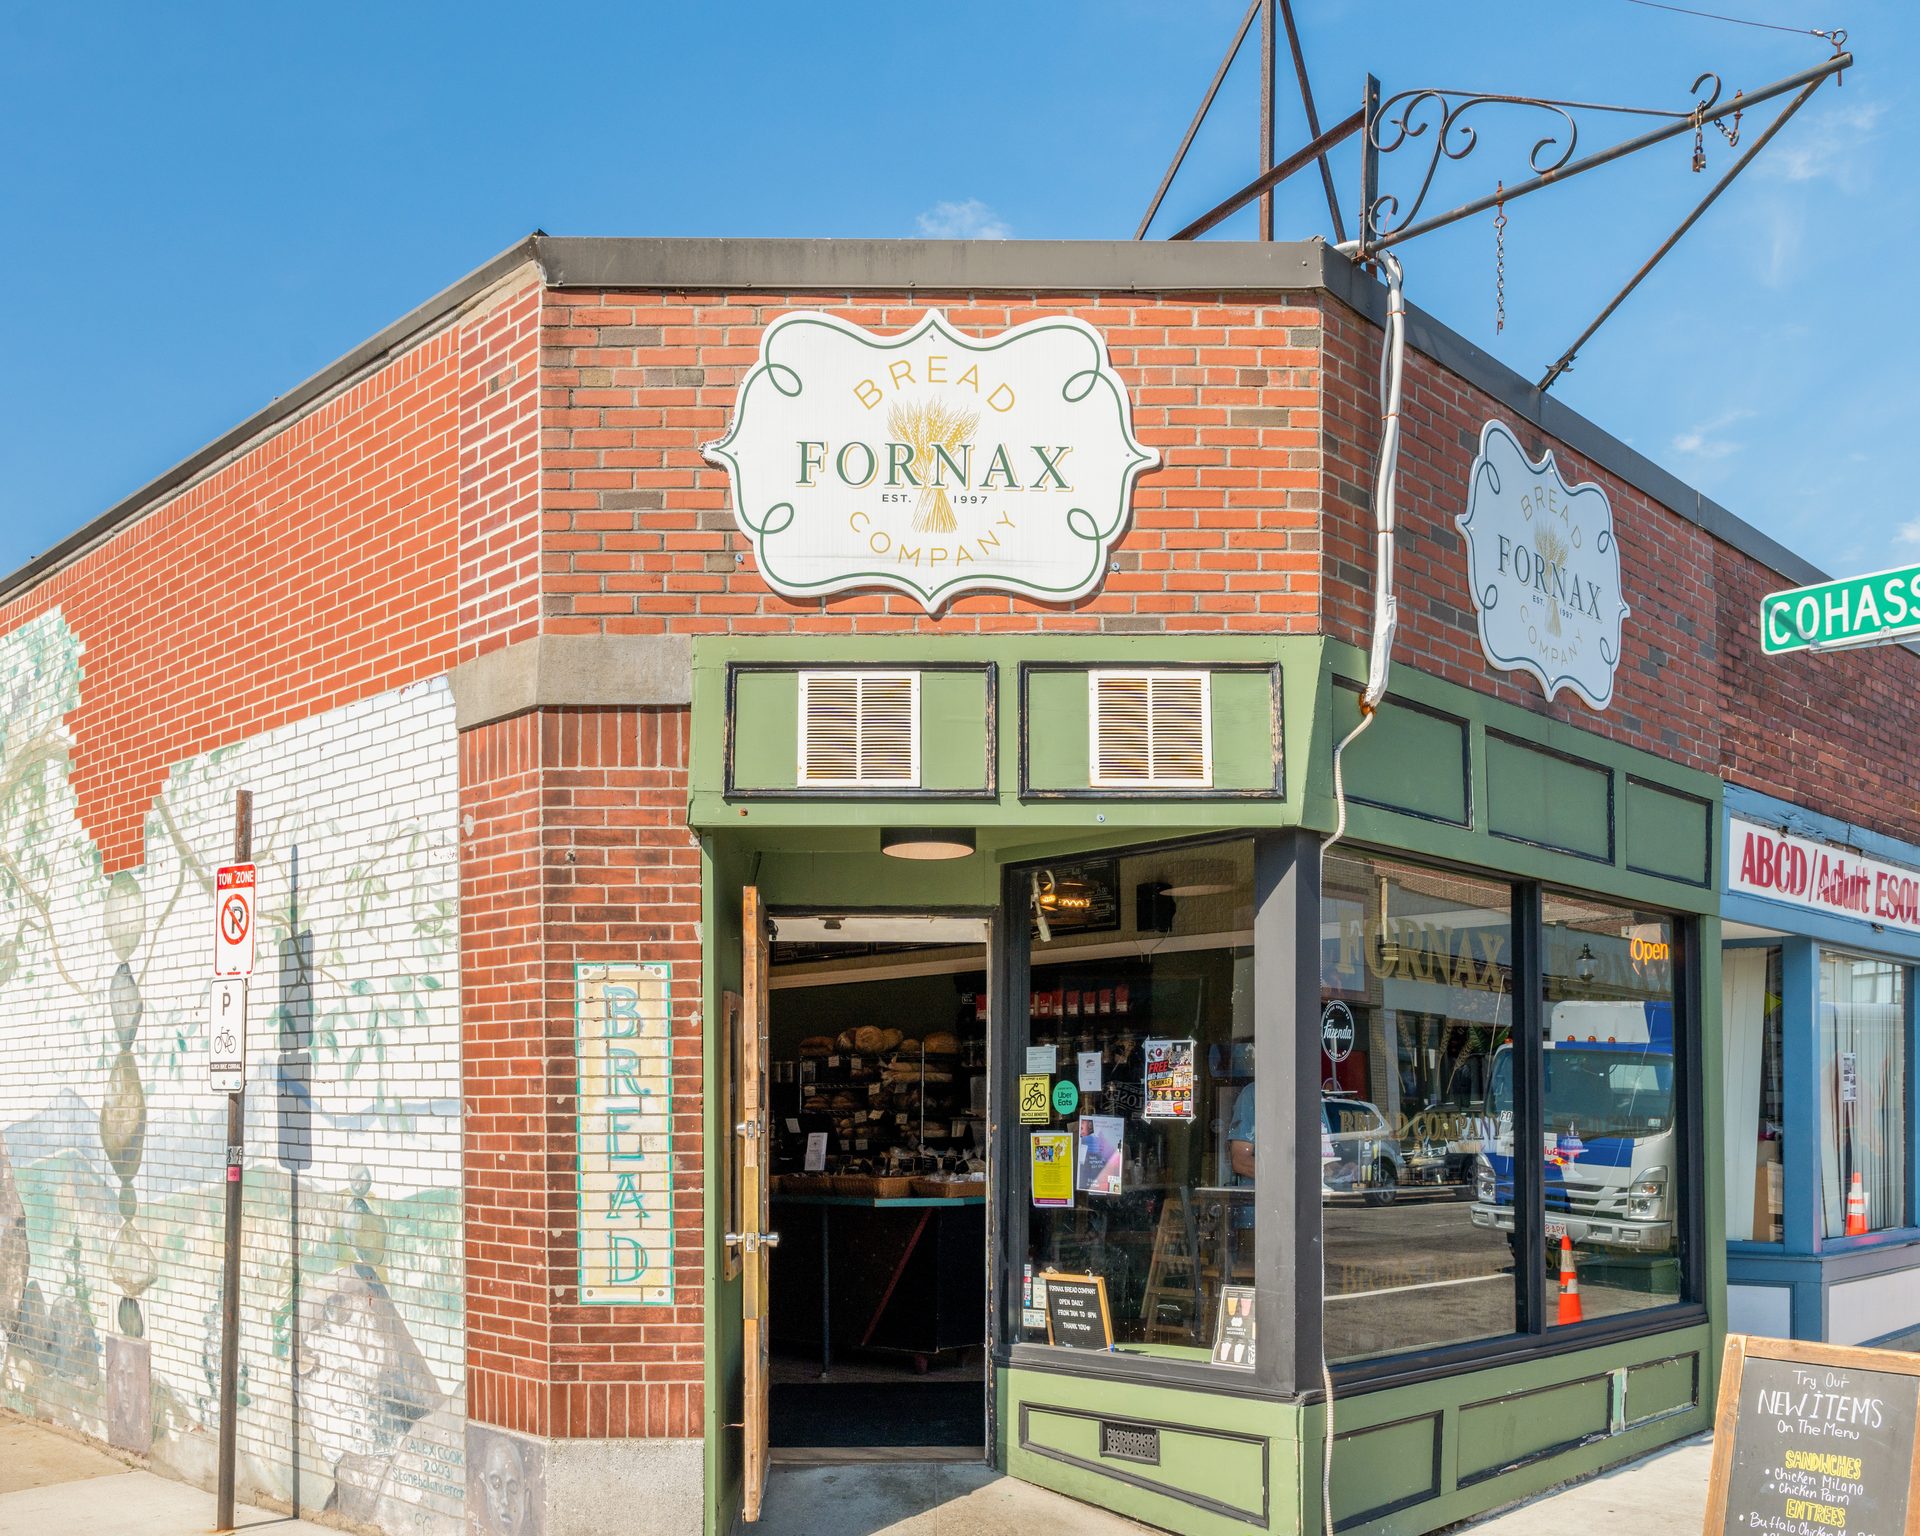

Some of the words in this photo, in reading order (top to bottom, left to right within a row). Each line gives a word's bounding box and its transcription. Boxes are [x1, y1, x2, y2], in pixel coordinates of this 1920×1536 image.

[853, 355, 1015, 413] BREAD
[795, 440, 1074, 492] FORNAX
[882, 494, 911, 503] EST.
[953, 495, 988, 505] 1997
[1520, 486, 1582, 549] BREAD
[849, 510, 1016, 568] COMPANY
[1497, 534, 1603, 623] FORNAX
[1559, 608, 1573, 620] 1997
[1519, 604, 1583, 667] COMPANY
[218, 872, 232, 885] TOW
[236, 870, 254, 884] ZONE
[1336, 908, 1505, 993] FORNAX
[1633, 937, 1669, 966] Open
[222, 992, 231, 1016] P
[1323, 1019, 1352, 1039] Fazenda
[1149, 1060, 1169, 1073] FREE
[602, 984, 651, 1284] BREAD
[1413, 1111, 1502, 1141] COMPANY
[1071, 1299, 1084, 1307] DAILY
[1077, 1287, 1096, 1295] COMPANY
[1062, 1321, 1078, 1330] THANK
[1792, 1370, 1817, 1390] Try
[1757, 1389, 1808, 1416] NEW
[1777, 1420, 1793, 1434] On
[1798, 1419, 1821, 1436] The
[1824, 1422, 1860, 1440] Menu
[437, 1446, 464, 1464] COOK
[1774, 1467, 1816, 1486] Chicken
[1822, 1476, 1864, 1496] Milano
[1779, 1482, 1817, 1499] Chicken
[1821, 1489, 1850, 1505] Parm
[1750, 1511, 1796, 1534] Buffalo
[1785, 1498, 1846, 1528] ENTREES
